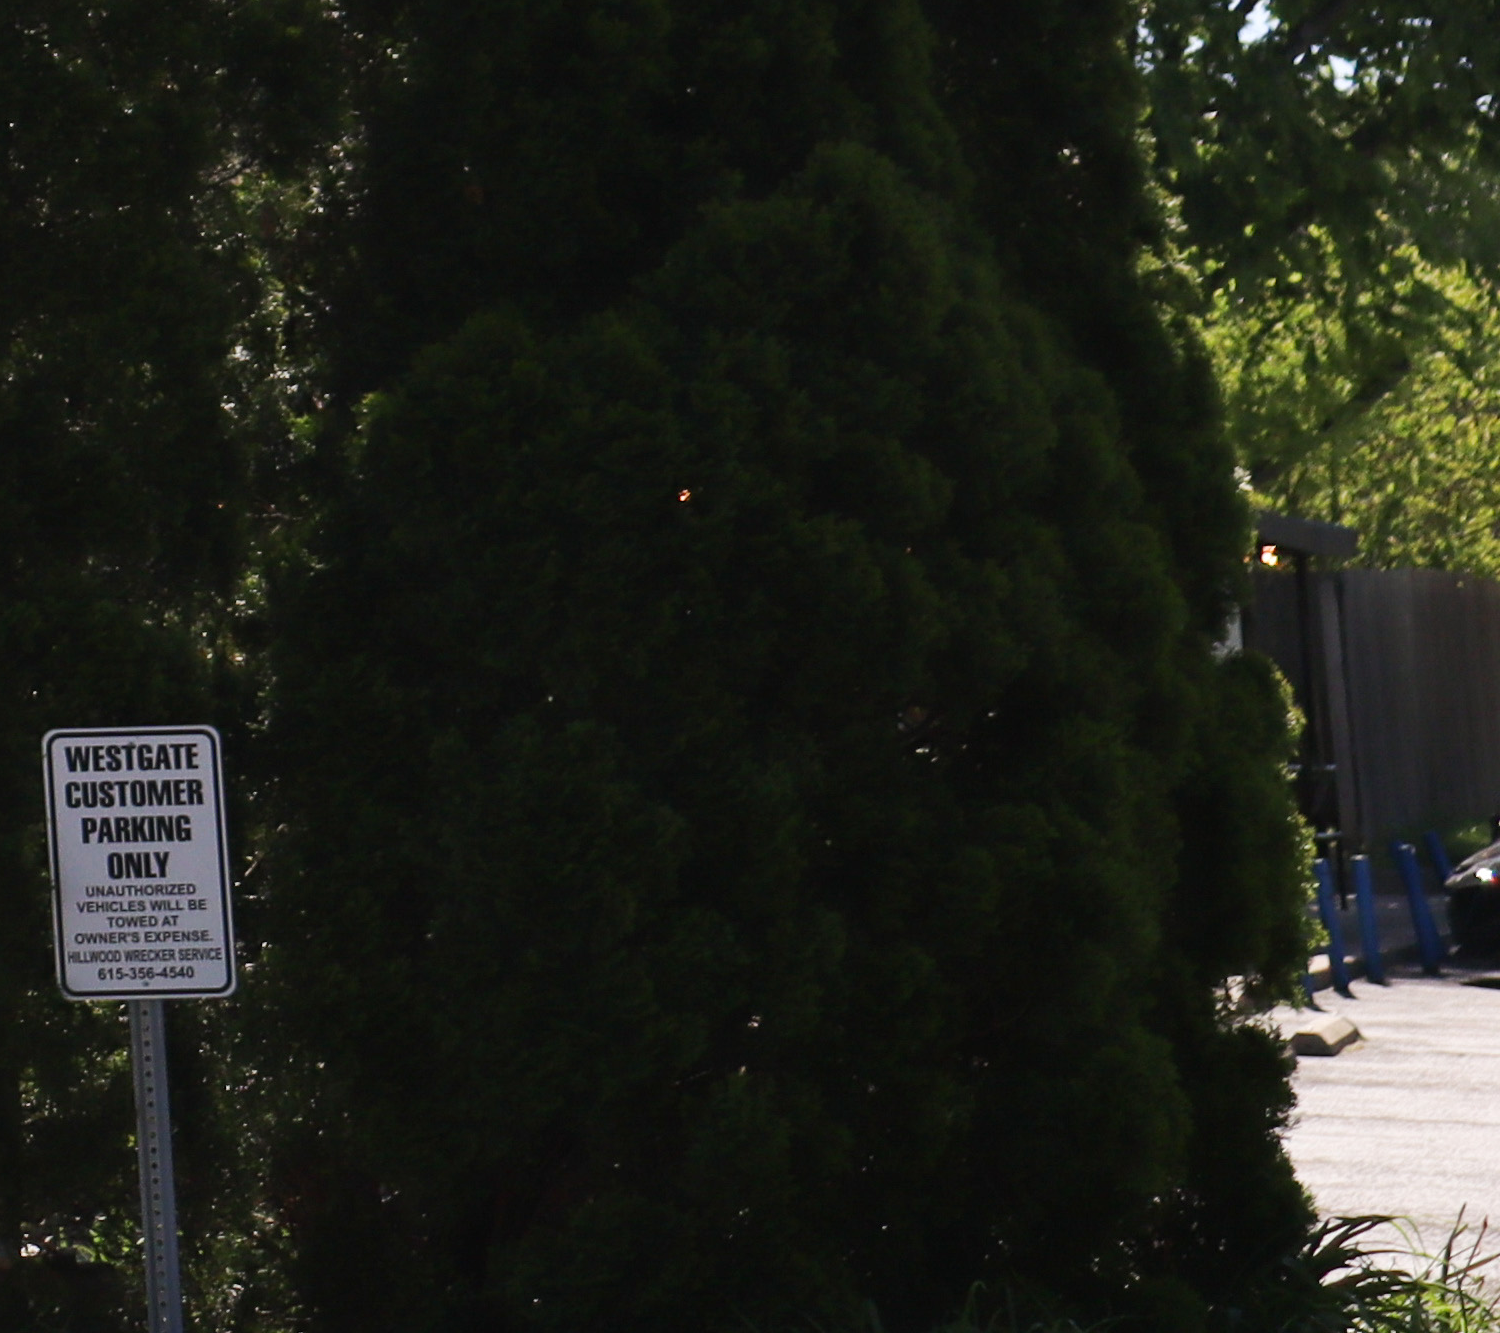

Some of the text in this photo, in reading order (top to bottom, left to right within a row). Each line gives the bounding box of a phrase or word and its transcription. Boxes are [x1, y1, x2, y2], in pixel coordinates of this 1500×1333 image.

[64, 743, 199, 773] WESTGATE
[64, 779, 204, 809] CUSTOMER
[81, 815, 192, 844] PARKING
[107, 851, 170, 880] ONLY
[85, 884, 196, 897] UNAUTHORIZED
[76, 899, 207, 913] VEHICLES WILL BE
[107, 915, 179, 928] TOWED AT
[74, 930, 214, 944] OWNER'S EXPENSE.
[67, 947, 222, 963] HILLWOOD WRECKER SERVICE
[97, 966, 195, 980] 615-356-4540
